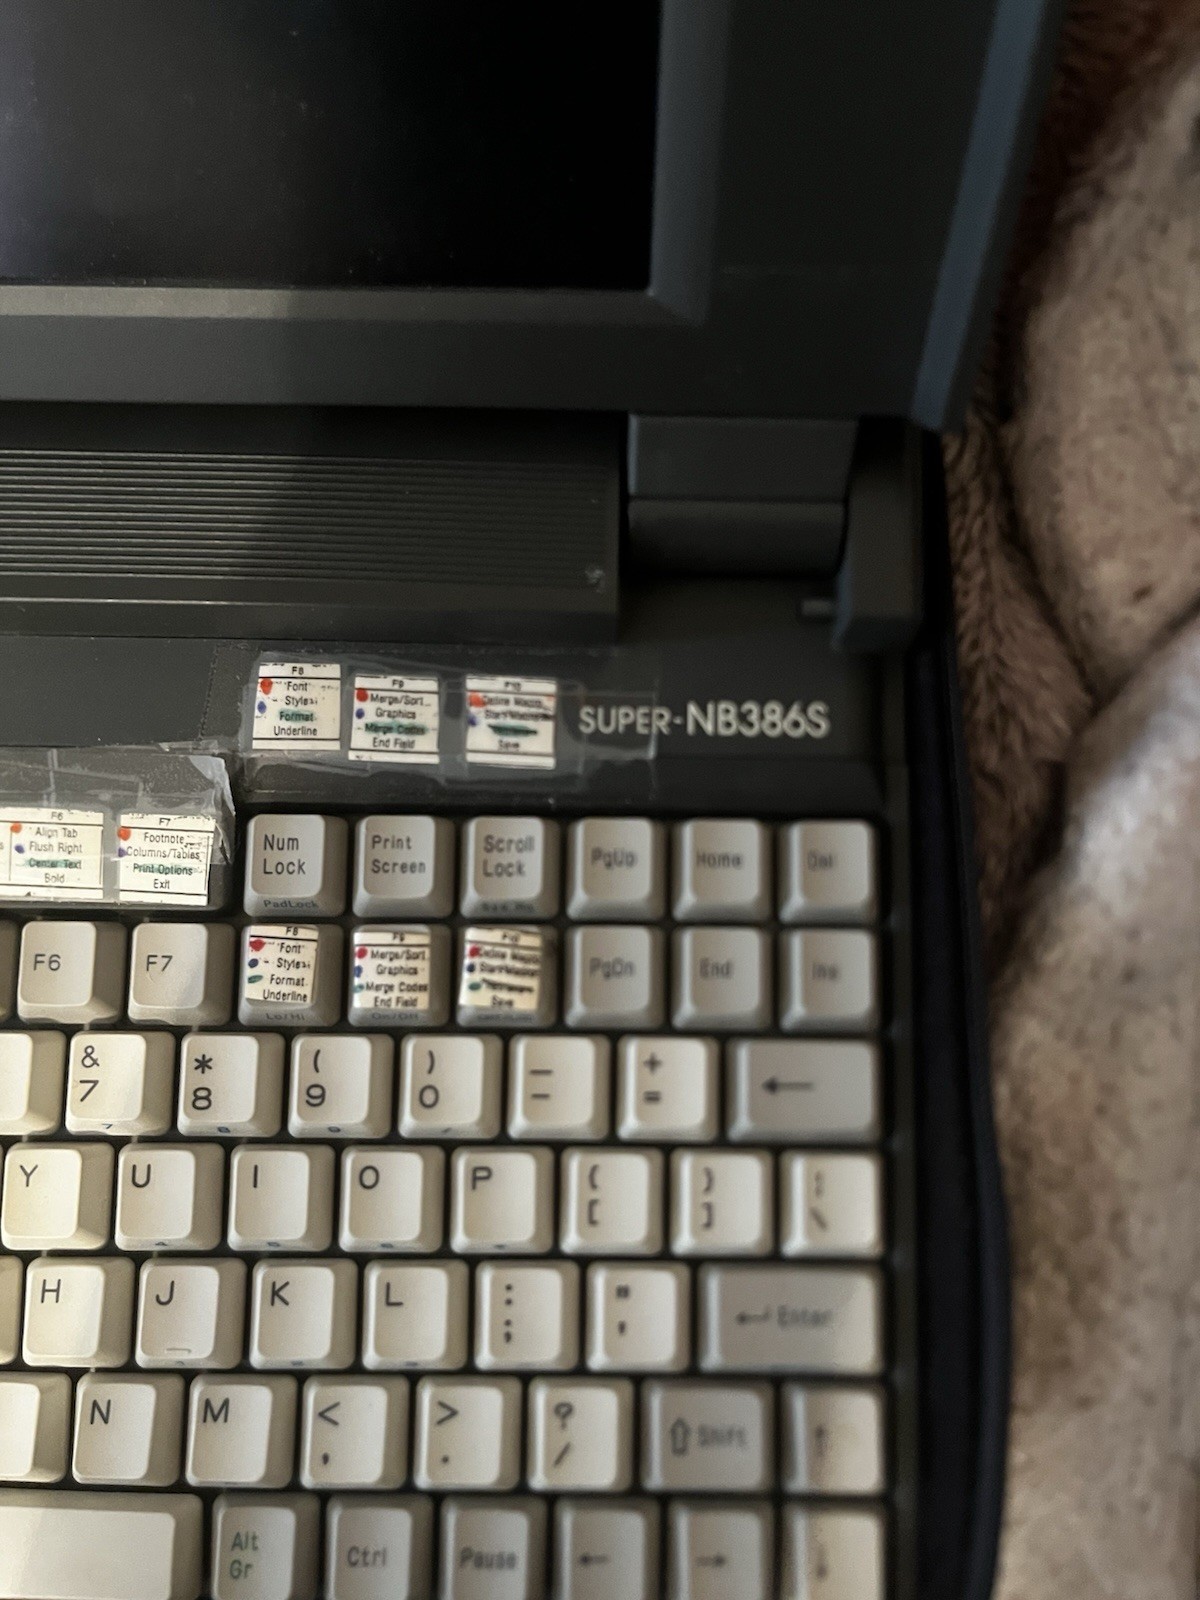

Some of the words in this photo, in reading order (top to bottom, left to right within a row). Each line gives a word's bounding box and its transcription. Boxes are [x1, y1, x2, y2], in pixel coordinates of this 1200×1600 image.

[291, 666, 304, 675] F8
[286, 681, 309, 691] Font
[370, 693, 424, 706] Merge/Sort
[279, 711, 314, 722] Format
[375, 707, 416, 719] Graphics
[578, 699, 831, 739] SUPER-NB386S
[273, 725, 318, 736] Underline
[372, 737, 390, 748] End
[51, 811, 64, 821] F6
[159, 817, 171, 826] F7
[35, 827, 58, 839] Align
[62, 828, 78, 838] Tab
[143, 832, 185, 845] Footnote
[29, 841, 54, 853] Flush
[57, 843, 83, 855] Right
[263, 834, 299, 851] Num
[371, 835, 412, 850] Print
[483, 835, 535, 852] Scroll
[126, 846, 200, 860] Columns/Tables
[590, 847, 637, 871] PgUp
[696, 850, 743, 870] Home
[63, 860, 81, 870] Text
[133, 863, 154, 874] Print
[157, 864, 193, 876] Options
[263, 859, 306, 875] Lock
[371, 859, 426, 874] Screen
[482, 861, 526, 878] Lock
[153, 878, 170, 890] Exit
[286, 926, 299, 936] F8
[280, 942, 302, 954] Font
[370, 950, 426, 962] Merge/Sort
[33, 954, 61, 971] F6
[146, 955, 173, 971] F7
[376, 963, 419, 976] Graphics
[700, 958, 732, 979] End
[269, 974, 305, 987] Format
[365, 982, 395, 994] Merge
[399, 981, 428, 992] Codes
[263, 989, 308, 1002] Underline
[373, 996, 392, 1008] End
[396, 997, 418, 1007] Field
[81, 1045, 100, 1069] &
[312, 1049, 321, 1073] (
[428, 1050, 435, 1074] )
[643, 1052, 662, 1074] +
[78, 1080, 99, 1102] 7
[192, 1086, 212, 1110] 8
[305, 1084, 326, 1107] 9
[419, 1085, 439, 1108] 0
[643, 1090, 661, 1103] =
[19, 1164, 38, 1188] Y
[131, 1164, 151, 1188] U
[358, 1165, 380, 1189] O
[471, 1166, 492, 1190] P
[40, 1279, 61, 1304] H
[155, 1280, 175, 1306] J
[270, 1281, 290, 1306] K
[384, 1282, 404, 1306] L
[776, 1305, 834, 1327] Enter
[90, 1400, 111, 1424] N
[203, 1398, 229, 1424] M
[318, 1401, 340, 1426] <
[436, 1402, 458, 1426] >
[554, 1402, 573, 1430] ?
[697, 1427, 748, 1448] Shift
[553, 1443, 571, 1468] /
[231, 1532, 259, 1552] Alt
[347, 1547, 387, 1568] Ctrl
[460, 1547, 518, 1570] Pause
[229, 1560, 254, 1580] Gr
